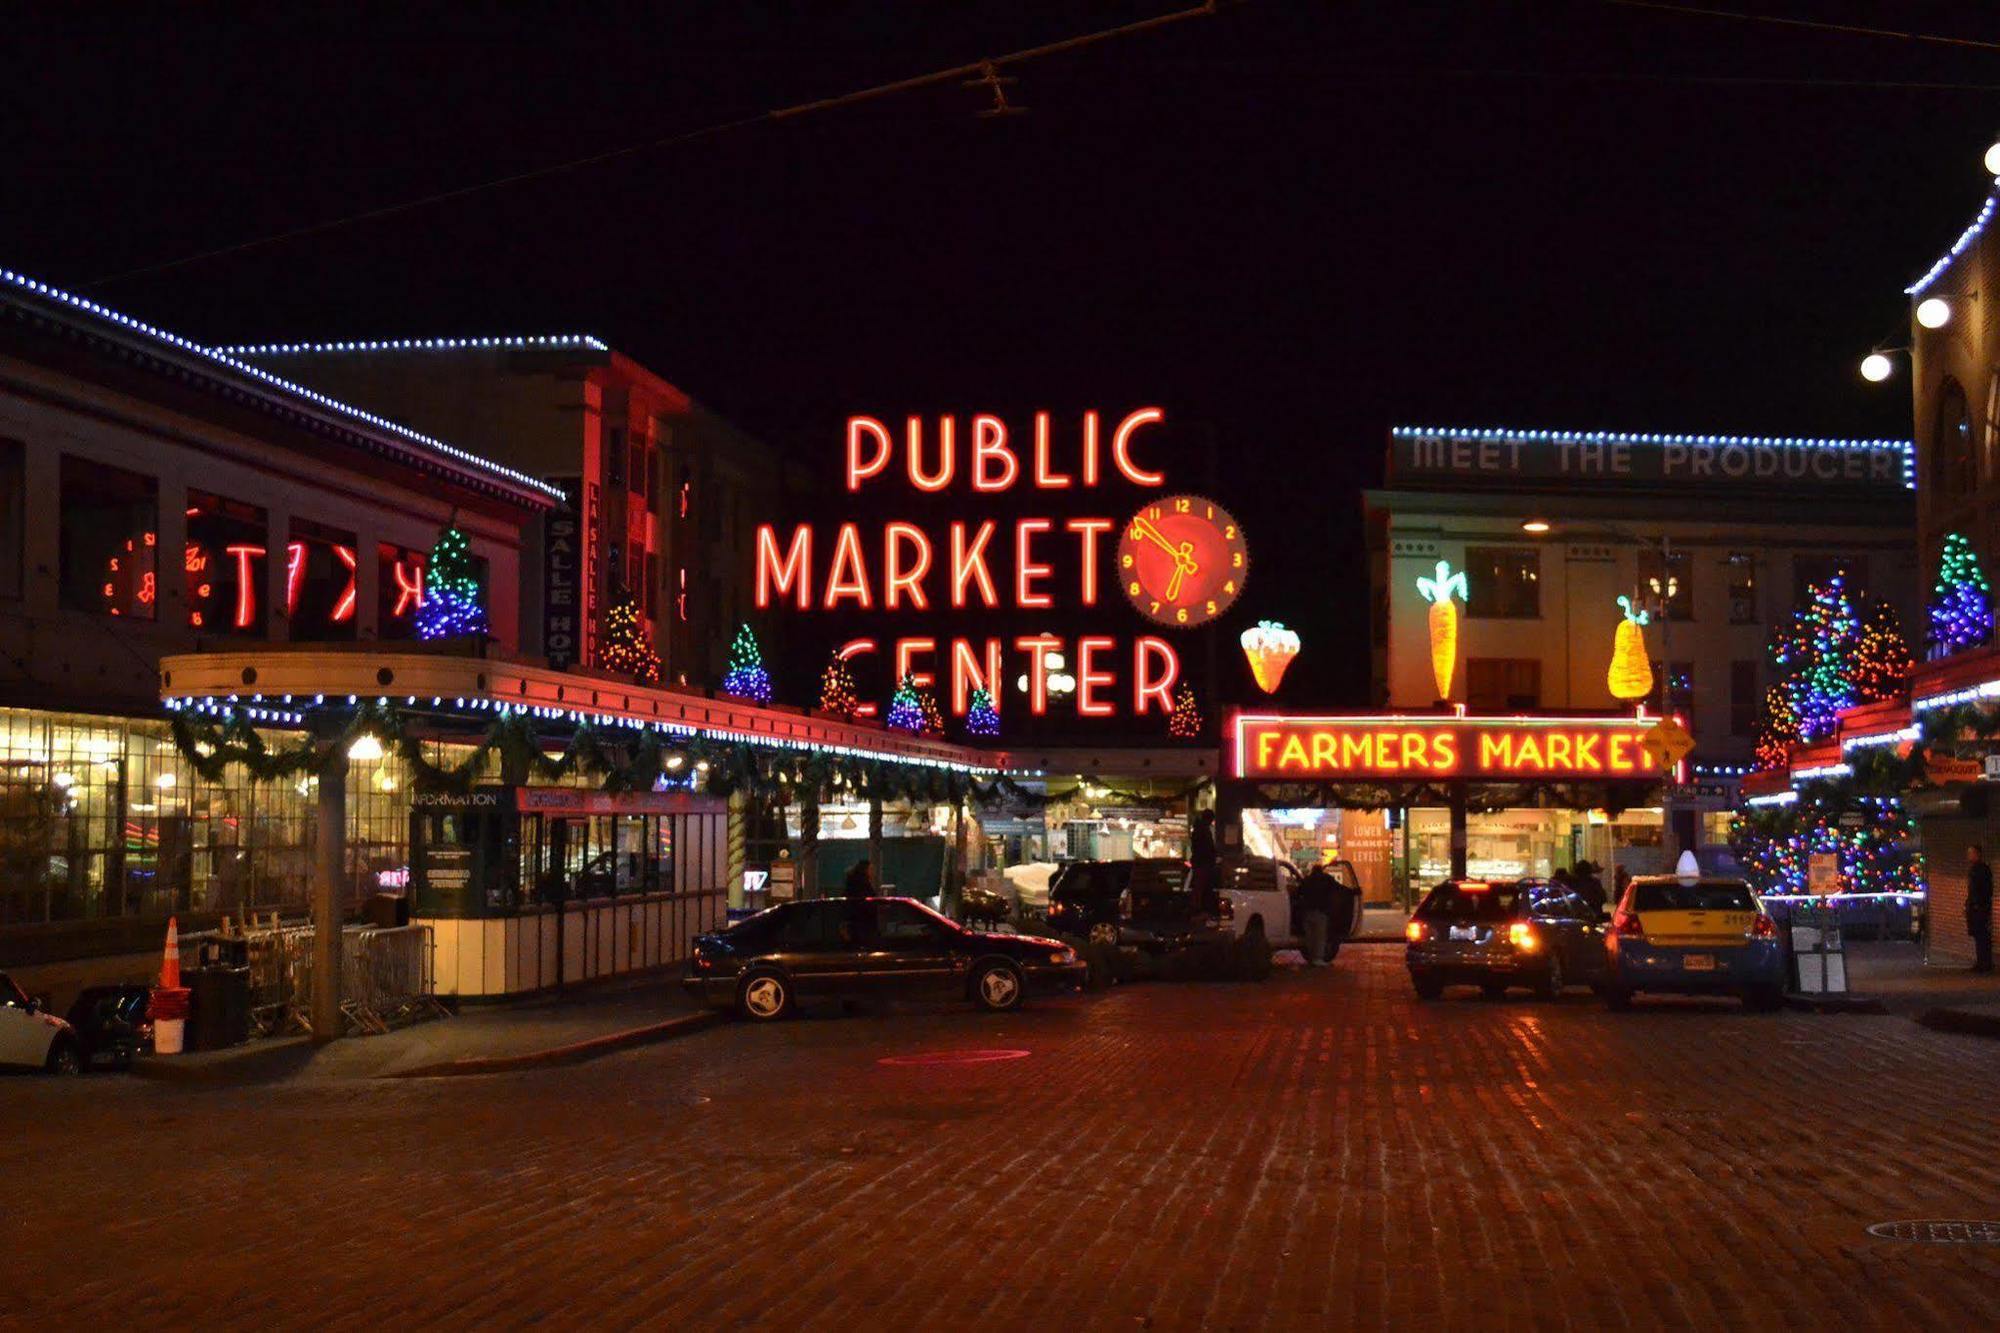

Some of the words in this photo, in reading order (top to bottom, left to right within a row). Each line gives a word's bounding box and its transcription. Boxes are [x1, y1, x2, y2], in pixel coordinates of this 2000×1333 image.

[845, 406, 1166, 491] PUBLIC
[1412, 434, 1526, 469] MEET
[1553, 438, 1632, 473] THE
[1663, 443, 1894, 479] PRODUCER
[1150, 507, 1161, 520] 11
[1175, 500, 1190, 513] 12
[1207, 506, 1213, 520] 1
[1129, 528, 1143, 540] 10
[1225, 525, 1235, 540] 2
[551, 520, 574, 605] SALLE
[754, 518, 1115, 609] MARKET
[1122, 554, 1133, 568] 9
[1233, 552, 1242, 567] 3
[588, 527, 598, 610] SALLE
[1129, 582, 1140, 596] 8
[1223, 580, 1235, 594] 4
[1151, 602, 1160, 614] 7
[1177, 608, 1187, 622] 6
[1206, 601, 1216, 615] 5
[838, 634, 1182, 718] CENTER
[1257, 731, 1456, 770] FARMERS
[411, 785, 497, 806] INFORMATION
[1353, 823, 1382, 837] LOWER
[1352, 850, 1384, 863] LEVELS
